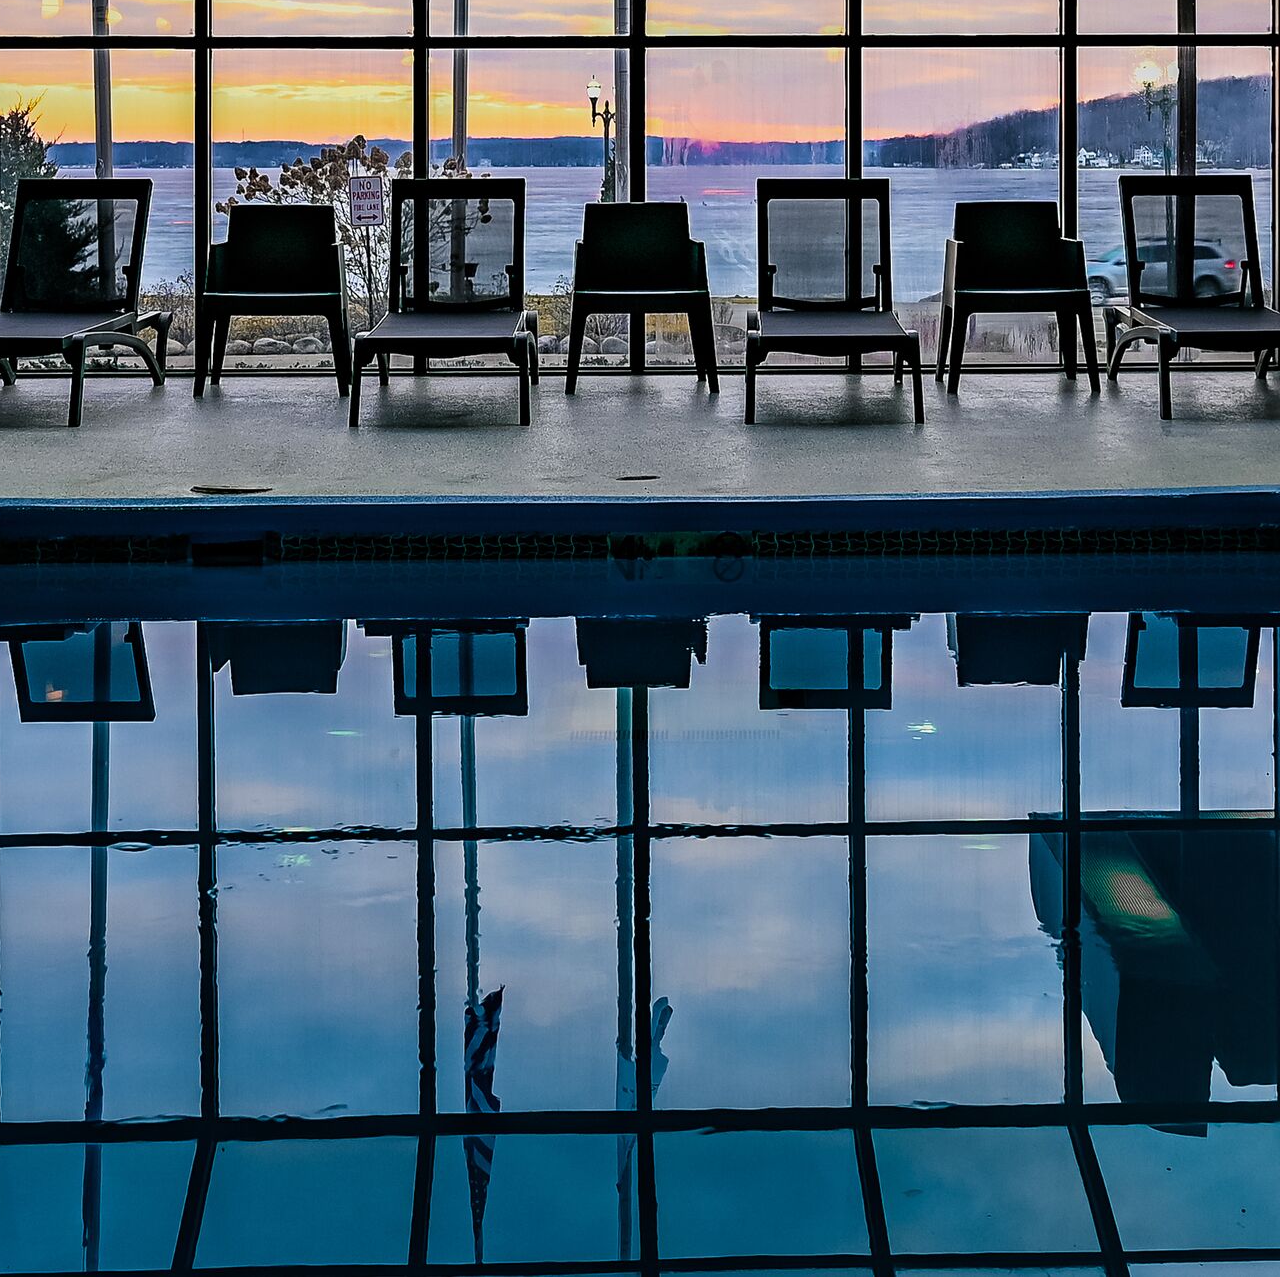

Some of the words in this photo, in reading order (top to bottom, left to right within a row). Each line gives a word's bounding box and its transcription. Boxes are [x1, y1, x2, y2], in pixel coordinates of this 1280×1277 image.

[360, 181, 372, 190] NO
[352, 191, 380, 200] PARKING
[366, 203, 380, 211] LANE
